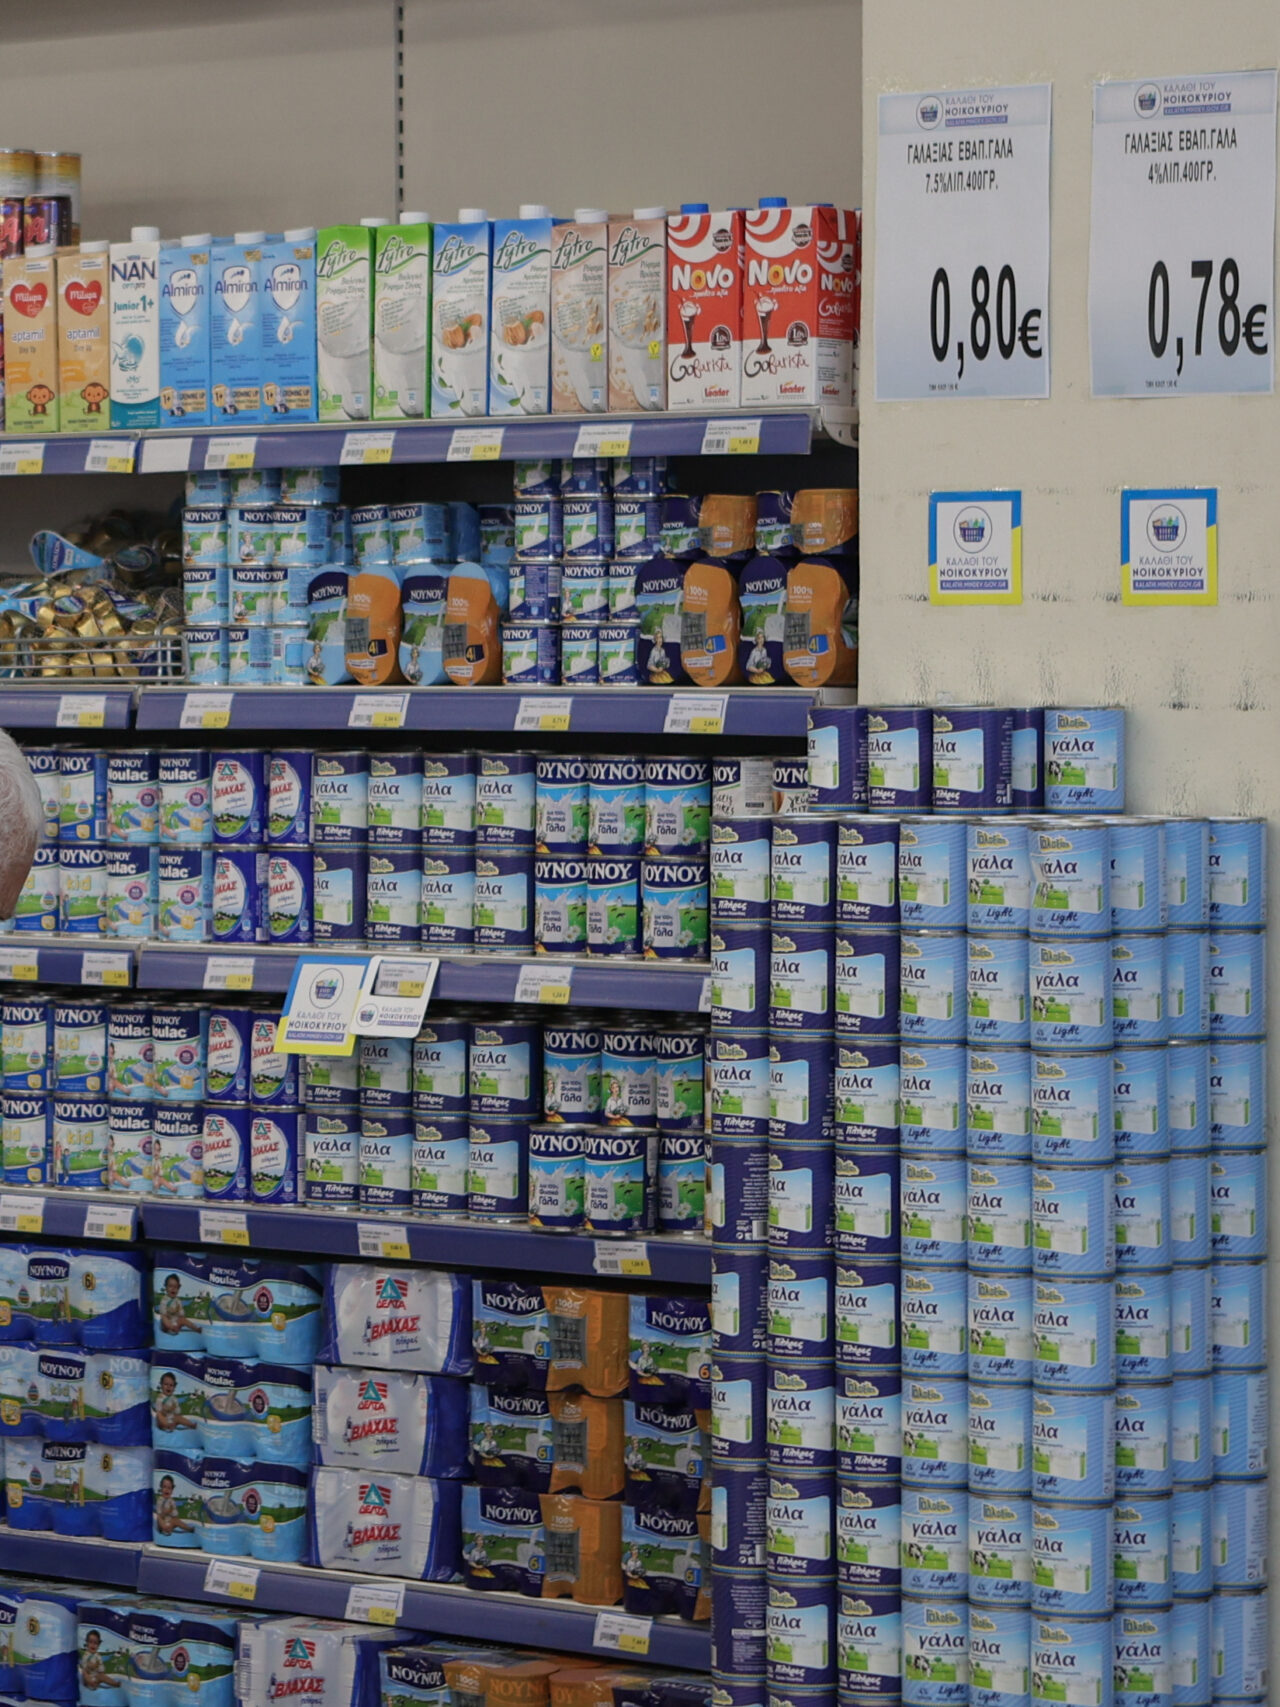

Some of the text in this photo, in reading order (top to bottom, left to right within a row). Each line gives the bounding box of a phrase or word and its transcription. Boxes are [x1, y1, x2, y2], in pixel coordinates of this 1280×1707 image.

[1164, 81, 1217, 93] ΚΑΛΑΘΙ ΤΟΥ
[979, 94, 994, 103] ΤΟΥ
[1163, 92, 1231, 104] ΝΟΙΚΟΚΥΡΙΟΥ
[945, 104, 1009, 116] ΝΟΙΚΟΚΥΡΙΟΥ
[1124, 128, 1238, 154] ΓΑΛΑΞΙΑΣ ΕΒΑΠ.ΓΑΛΑ
[907, 138, 1014, 164] ΓΑΛΑΞΙΑΣ ΕΒΑΠ.ΓΑΛΑ
[111, 261, 156, 281] NAN
[162, 281, 204, 298] Almiron
[214, 279, 258, 296] Almiron
[264, 277, 308, 293] Almiron
[114, 301, 139, 313] Junior
[11, 327, 45, 342] aptamil
[66, 327, 100, 341] aptamil
[946, 556, 999, 566] ΚΑΛΑΘΙ ΤΟΥ
[1139, 555, 1193, 566] ΚΑΛΑΘΙ ΤΟΥ
[940, 568, 1008, 577] ΝΟΙΚΟΚΥΡΙΟΥ
[1133, 567, 1203, 577] ΝΟΙΚΟΚΥΡΙΟΥ
[1052, 736, 1095, 755] γάλα
[479, 779, 512, 798] γάλα
[972, 855, 1013, 873] γάλα
[1036, 971, 1079, 989] γάλα
[288, 1020, 347, 1031] ΝΟΙΚΟΚΥΡΙΟΥ
[313, 1136, 352, 1154] γάλα
[972, 1305, 1015, 1324] γάλα
[371, 1316, 419, 1340] ΒΛΑΧΑΣ
[701, 1364, 710, 1379] 6
[771, 1396, 812, 1414] γάλα
[842, 1402, 884, 1421] γάλα
[906, 1407, 949, 1427] γάλα
[351, 1418, 398, 1441] ΒΛΑΧΑΣ
[353, 1524, 402, 1544] ΒΛΑΧΑΣ
[912, 1518, 957, 1538] γάλα
[977, 1527, 1022, 1545] γάλα
[920, 1630, 965, 1650] γάλα
[1034, 1651, 1076, 1668] γάλα
[1116, 1642, 1162, 1660] γάλα
